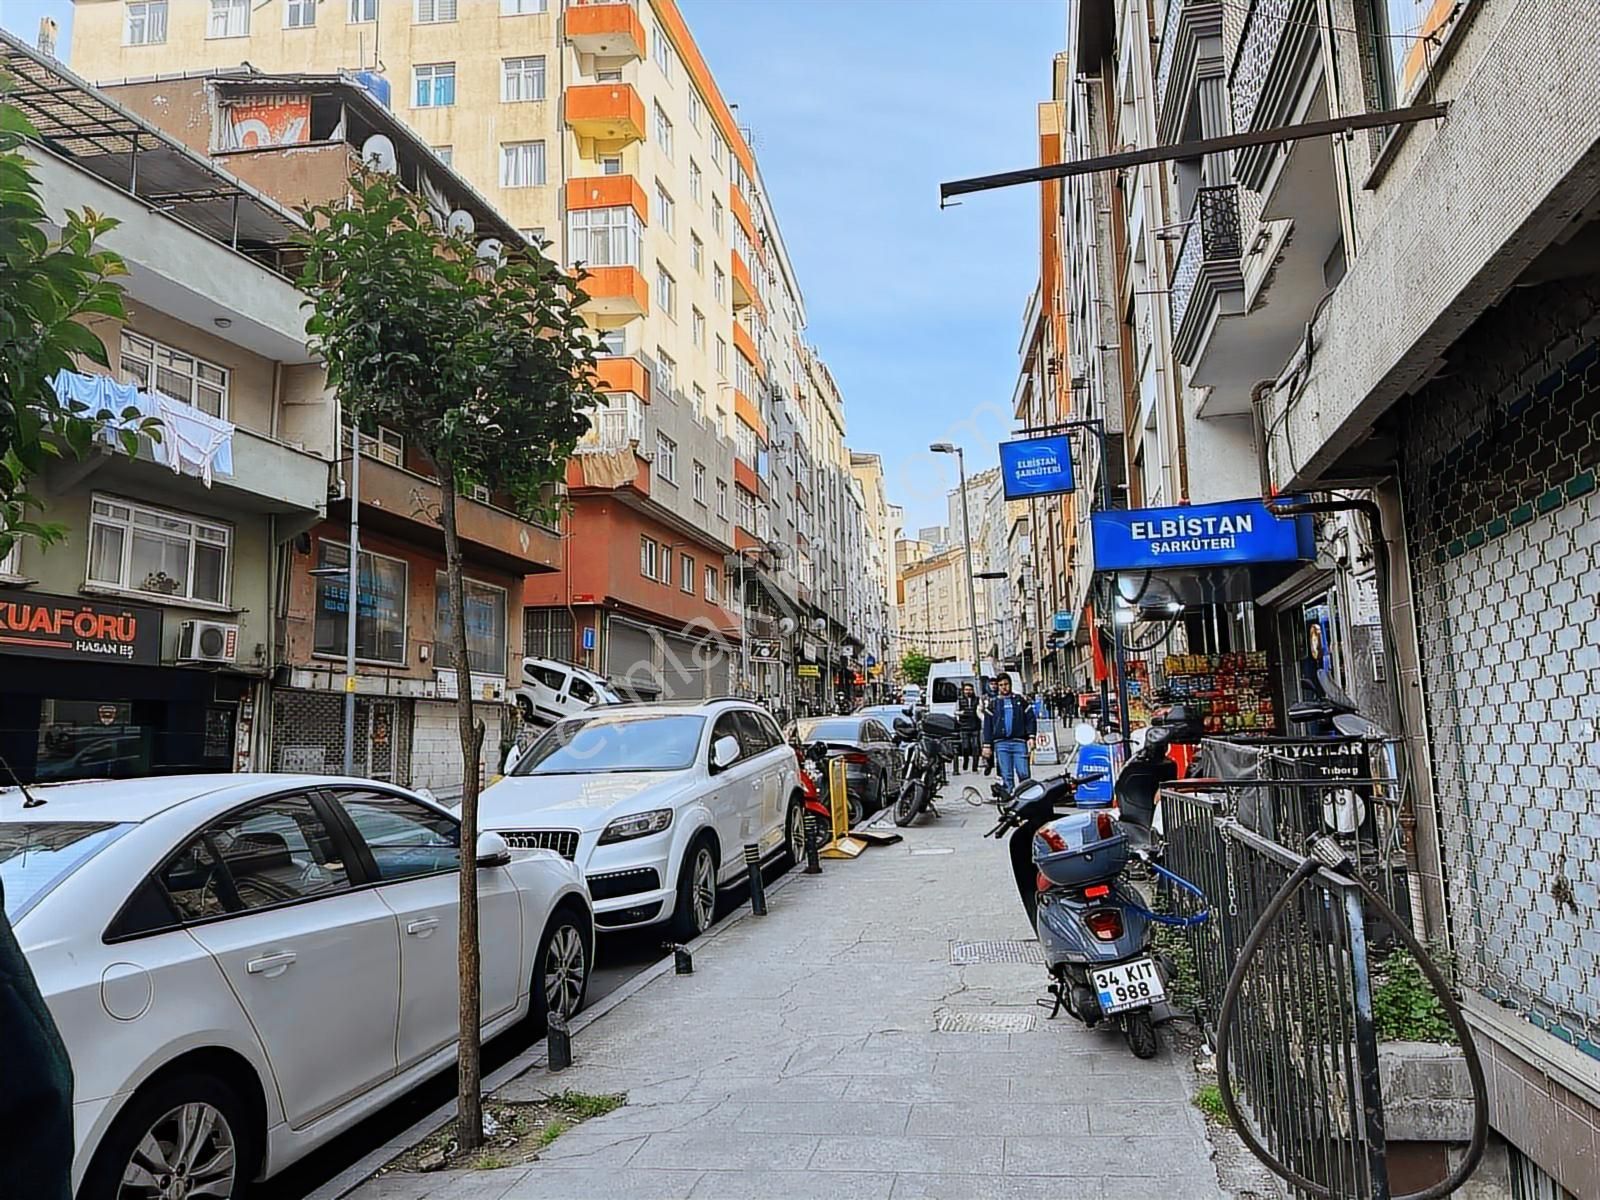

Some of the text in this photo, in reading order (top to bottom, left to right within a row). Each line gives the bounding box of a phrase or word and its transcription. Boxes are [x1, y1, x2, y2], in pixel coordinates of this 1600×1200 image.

[1131, 515, 1253, 540] ELBİSTAN
[1151, 535, 1236, 556] ŞARKÜTERİ
[75, 640, 117, 655] HASAN
[1096, 962, 1153, 989] 34 KIT
[1115, 981, 1150, 1002] 988
